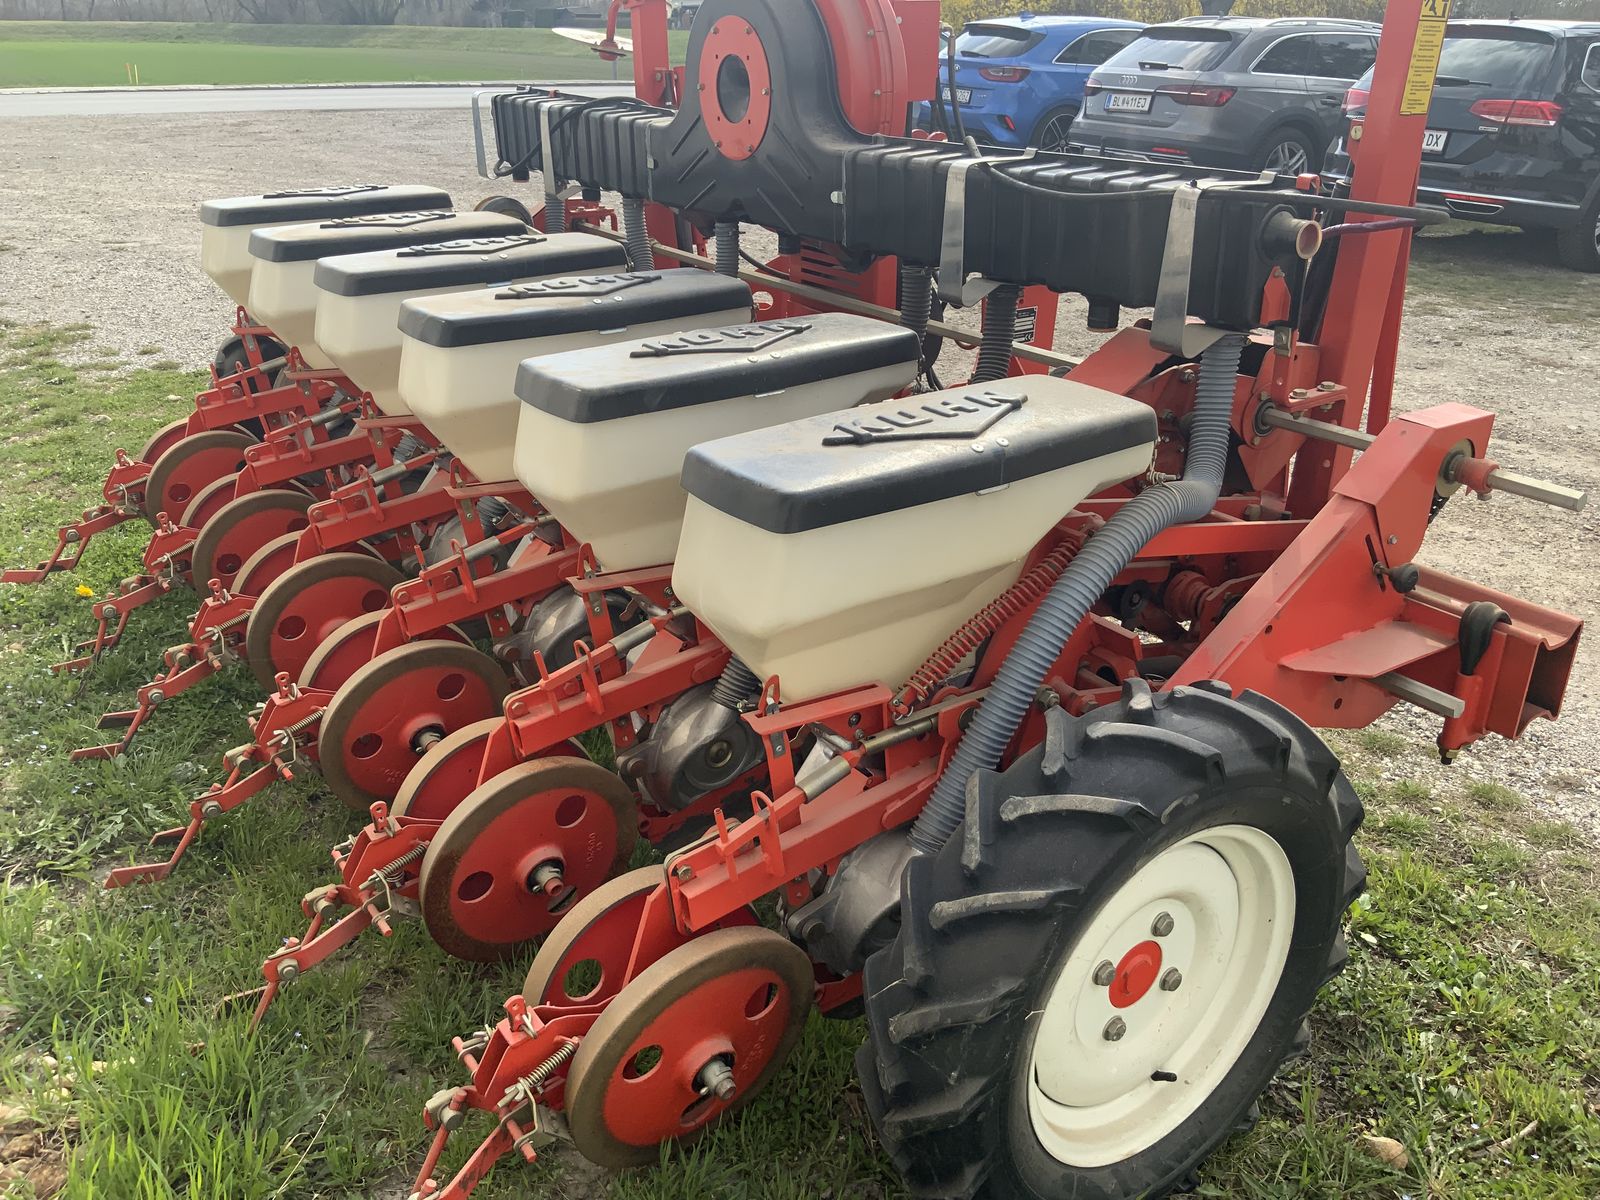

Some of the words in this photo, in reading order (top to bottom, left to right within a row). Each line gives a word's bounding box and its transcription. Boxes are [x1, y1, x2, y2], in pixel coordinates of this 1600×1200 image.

[502, 274, 661, 299] KUHN
[636, 322, 812, 357] KUHN
[828, 391, 1028, 445] KUHN
